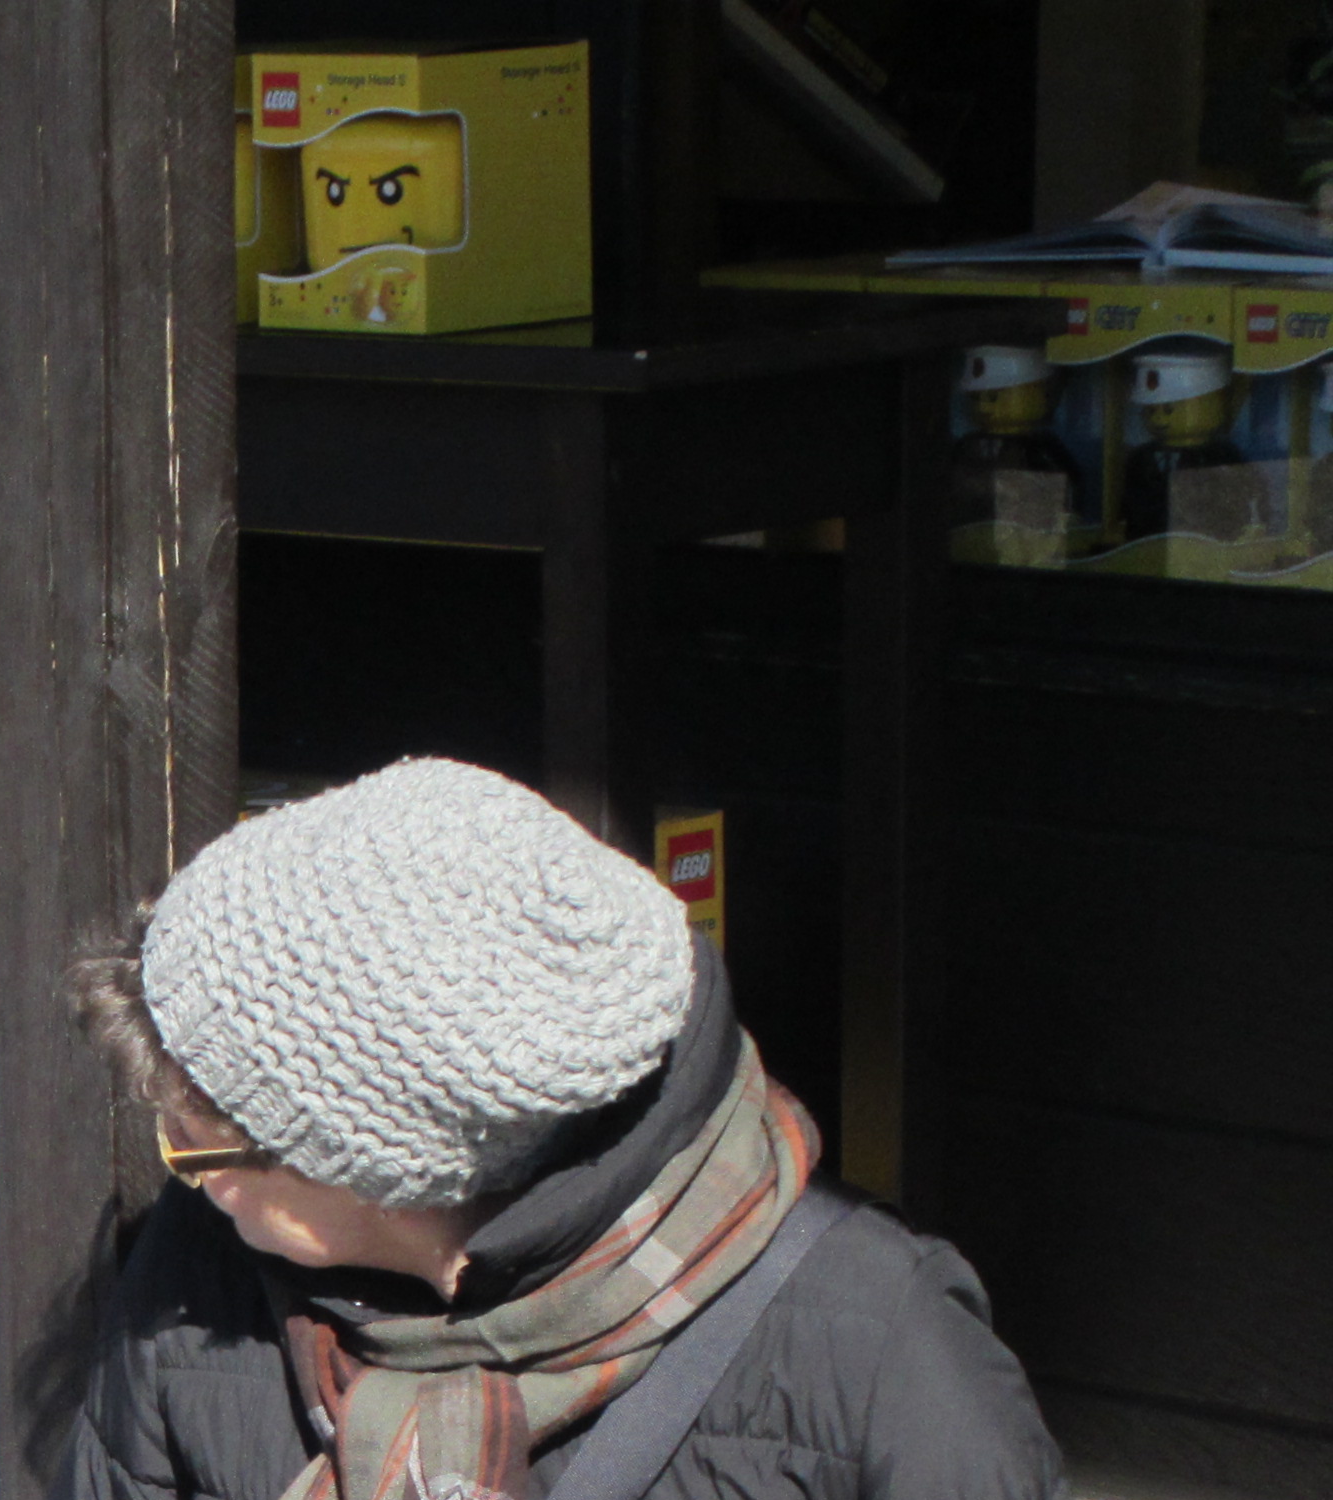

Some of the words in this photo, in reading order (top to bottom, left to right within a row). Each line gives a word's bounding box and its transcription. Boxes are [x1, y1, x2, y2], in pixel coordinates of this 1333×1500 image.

[327, 73, 366, 89] Storage
[368, 73, 395, 86] Head
[264, 89, 297, 110] LEGO
[671, 851, 710, 883] LEGO
